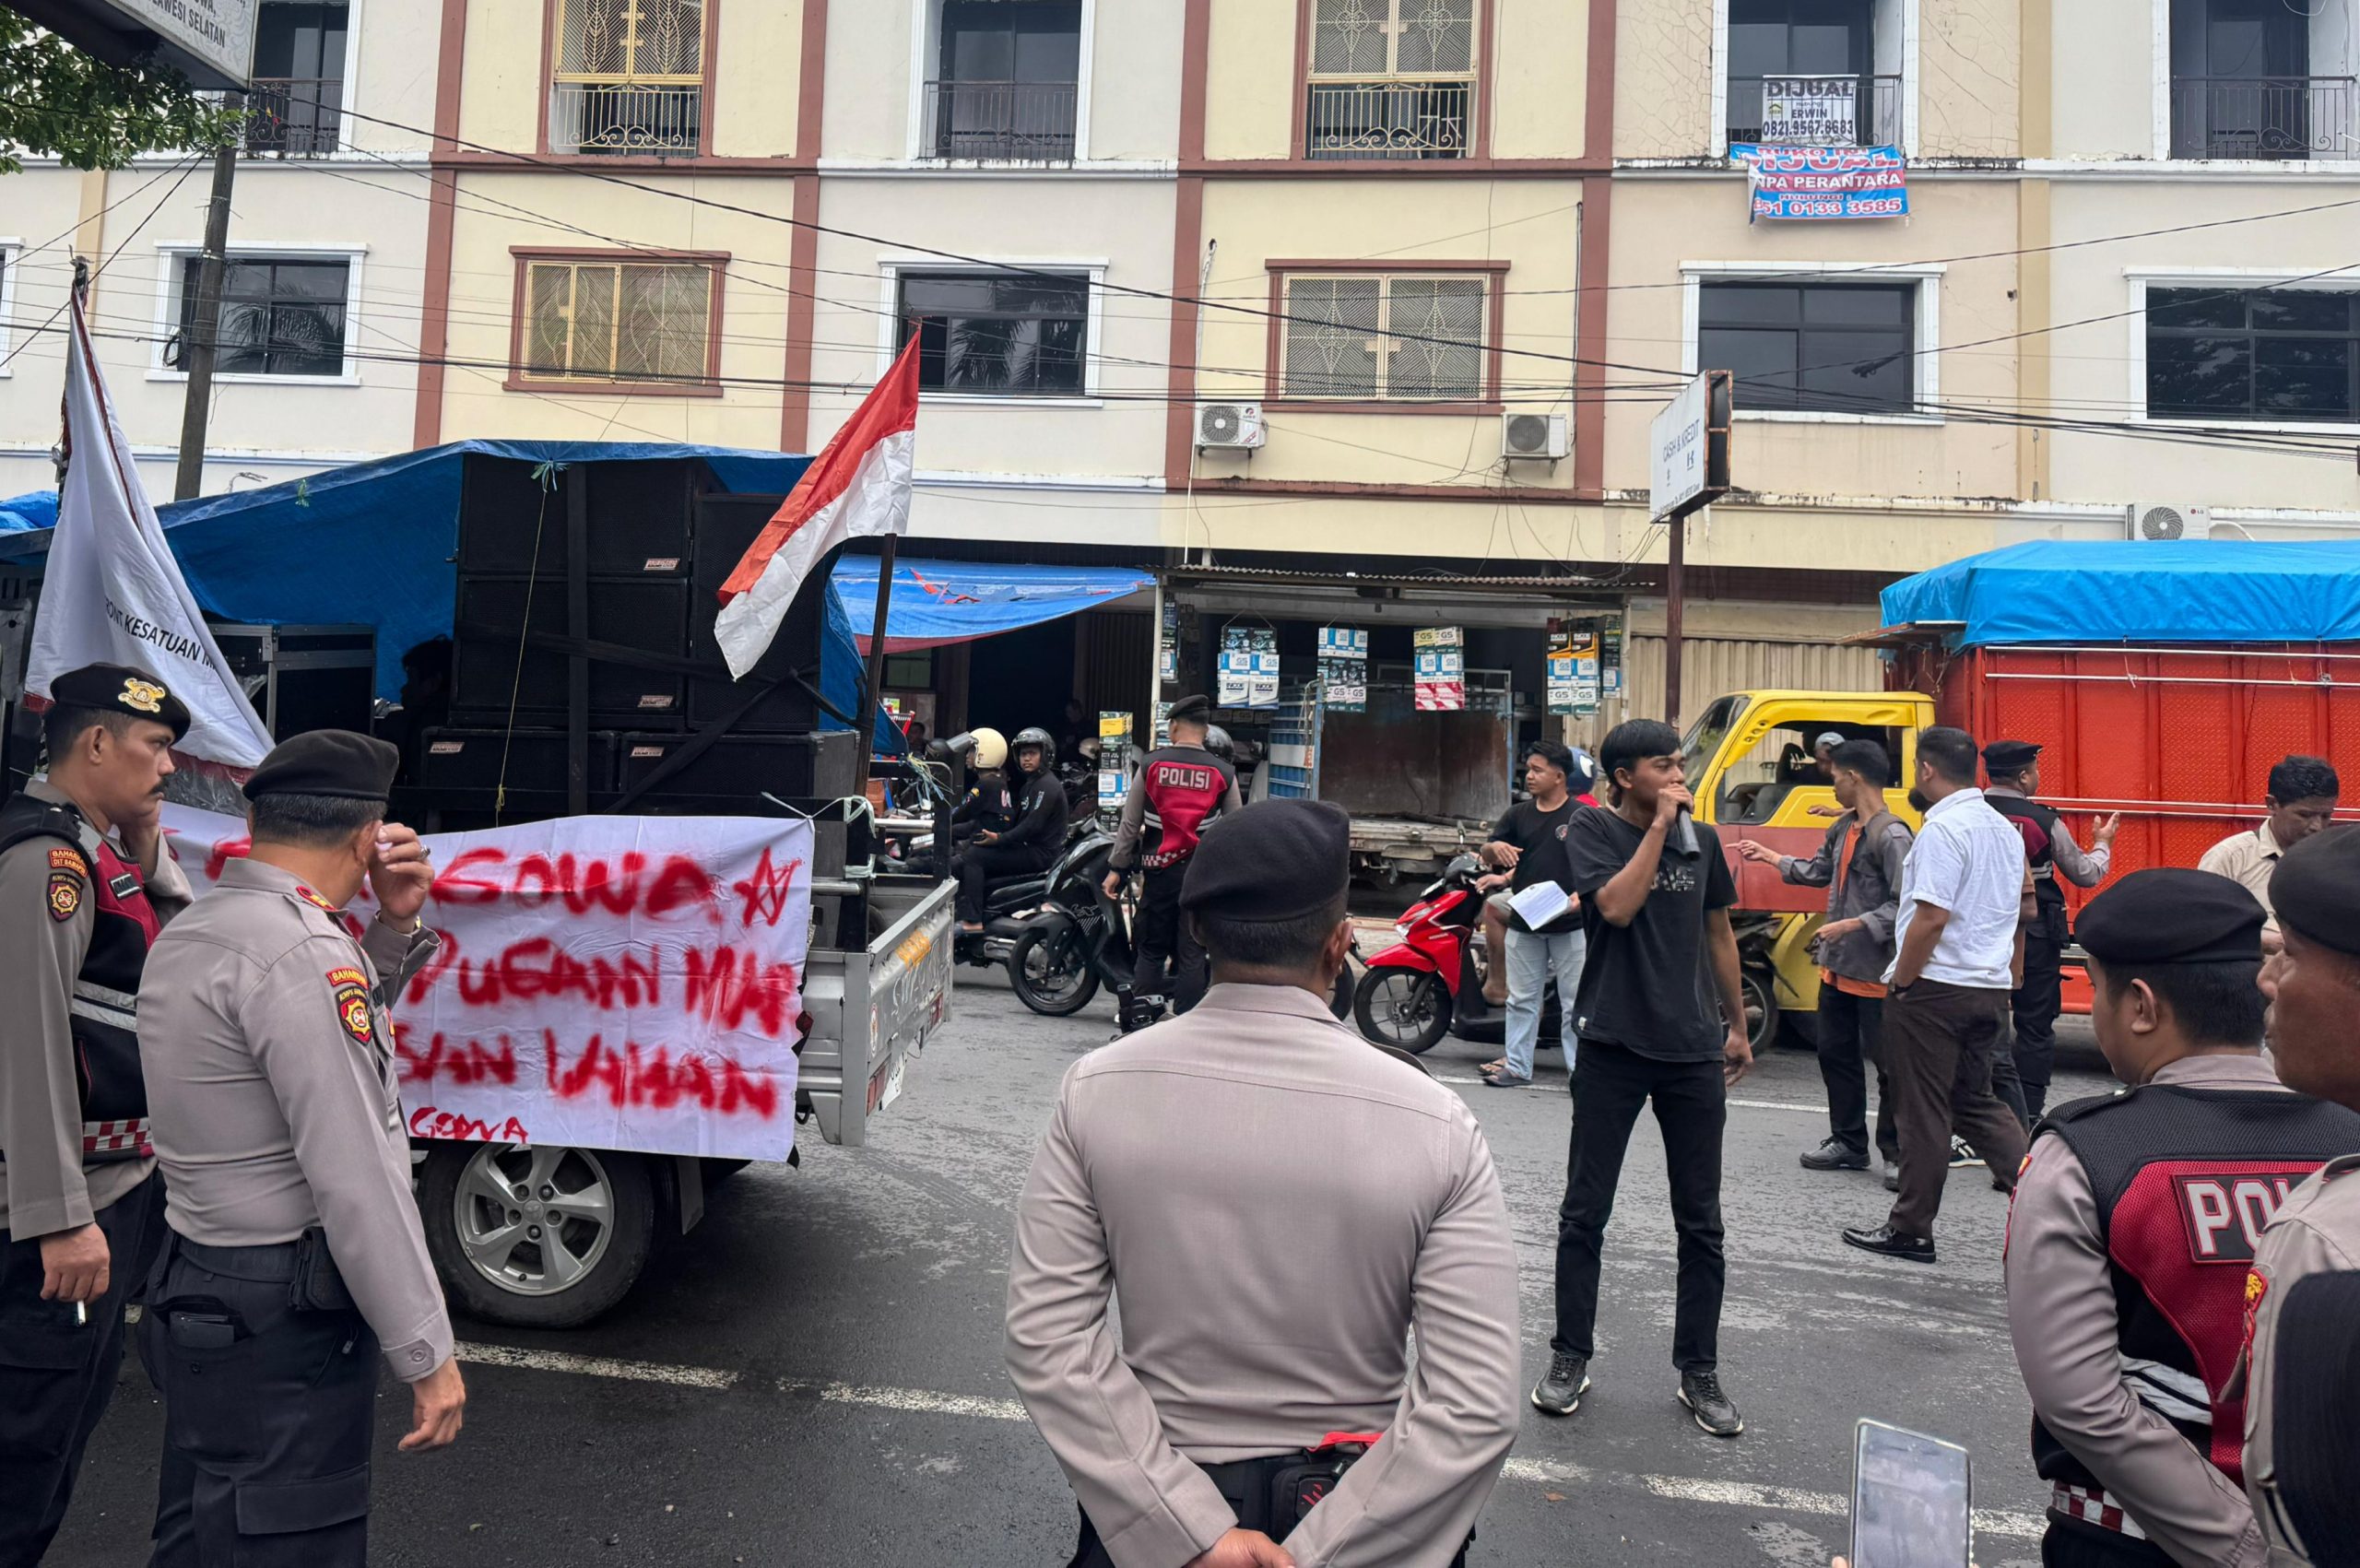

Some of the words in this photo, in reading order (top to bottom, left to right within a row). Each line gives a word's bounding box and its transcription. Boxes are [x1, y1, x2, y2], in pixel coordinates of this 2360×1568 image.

[188, 8, 226, 48] SELATAN
[1767, 81, 1854, 97] DIJUAL
[1791, 109, 1827, 118] ERWIN
[1763, 120, 1854, 136] 0821.9567.8683
[1757, 147, 1825, 156] RUKO
[1794, 174, 1901, 188] PERANTARA
[1790, 202, 1841, 214] 0133
[1848, 199, 1901, 214] 3585
[1682, 419, 1699, 448] KREDIT
[124, 615, 201, 661] KESATUAN
[1159, 766, 1210, 790] POLISI
[2186, 1179, 2290, 1255] PO
